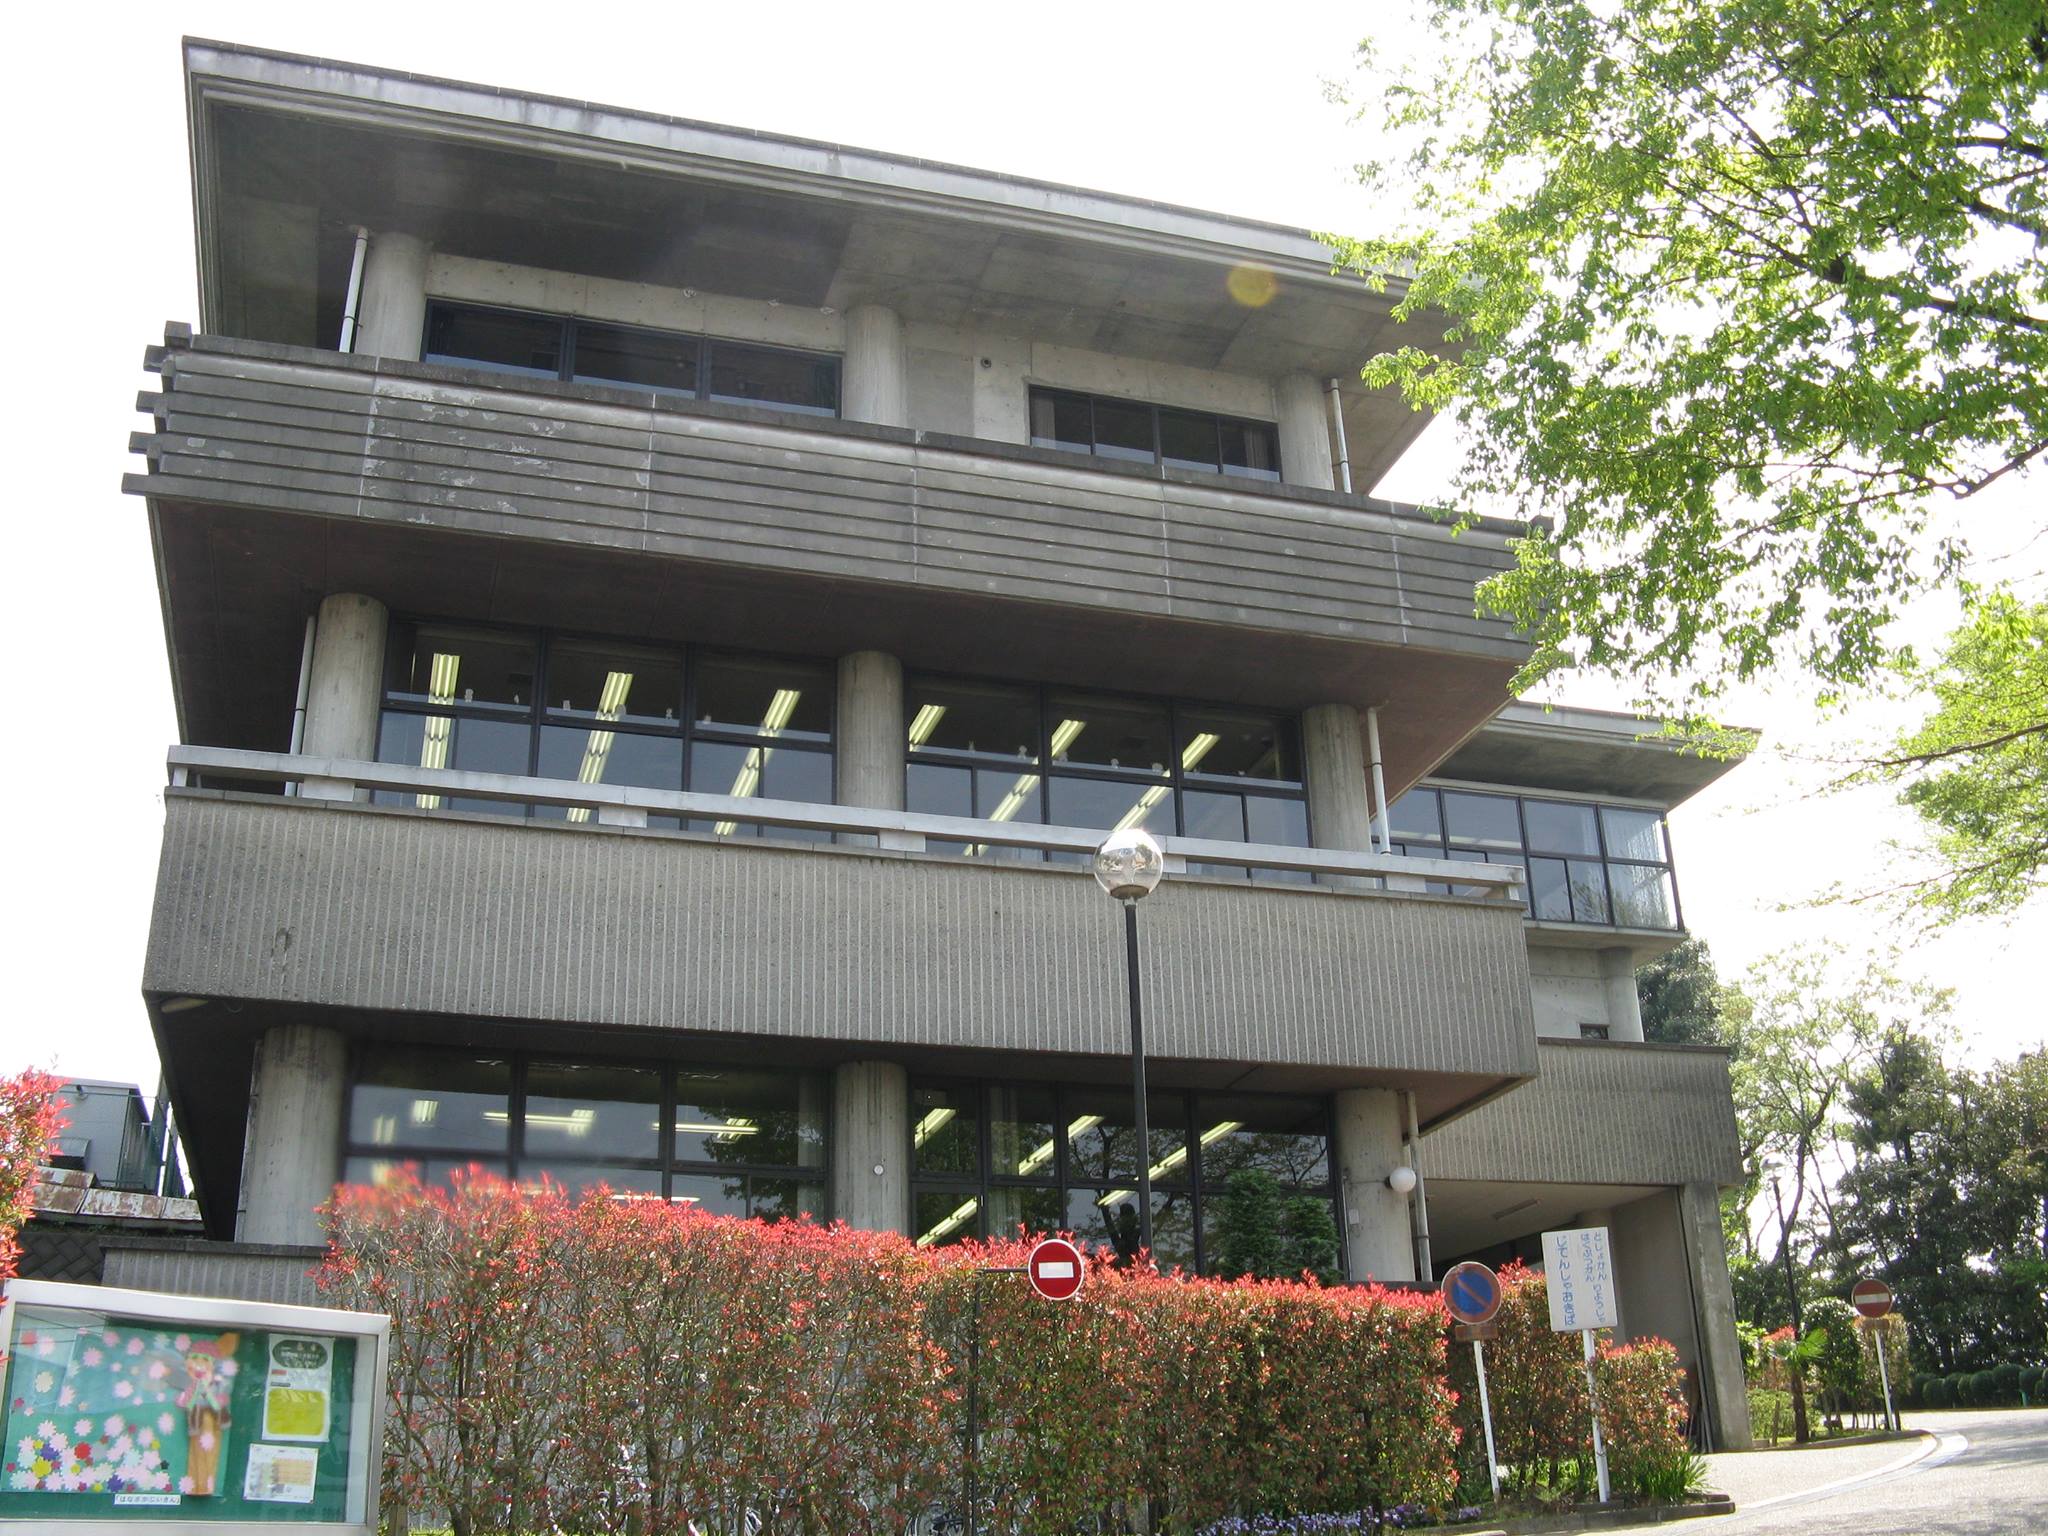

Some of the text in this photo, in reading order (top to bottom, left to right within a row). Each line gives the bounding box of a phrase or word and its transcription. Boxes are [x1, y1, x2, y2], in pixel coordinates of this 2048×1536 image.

[1556, 1235, 1576, 1326] じてんしゃおきば
[1580, 1233, 1594, 1282] はくぶつかん
[1594, 1231, 1607, 1281] としょかん
[1593, 1283, 1606, 1323] りようしゃ
